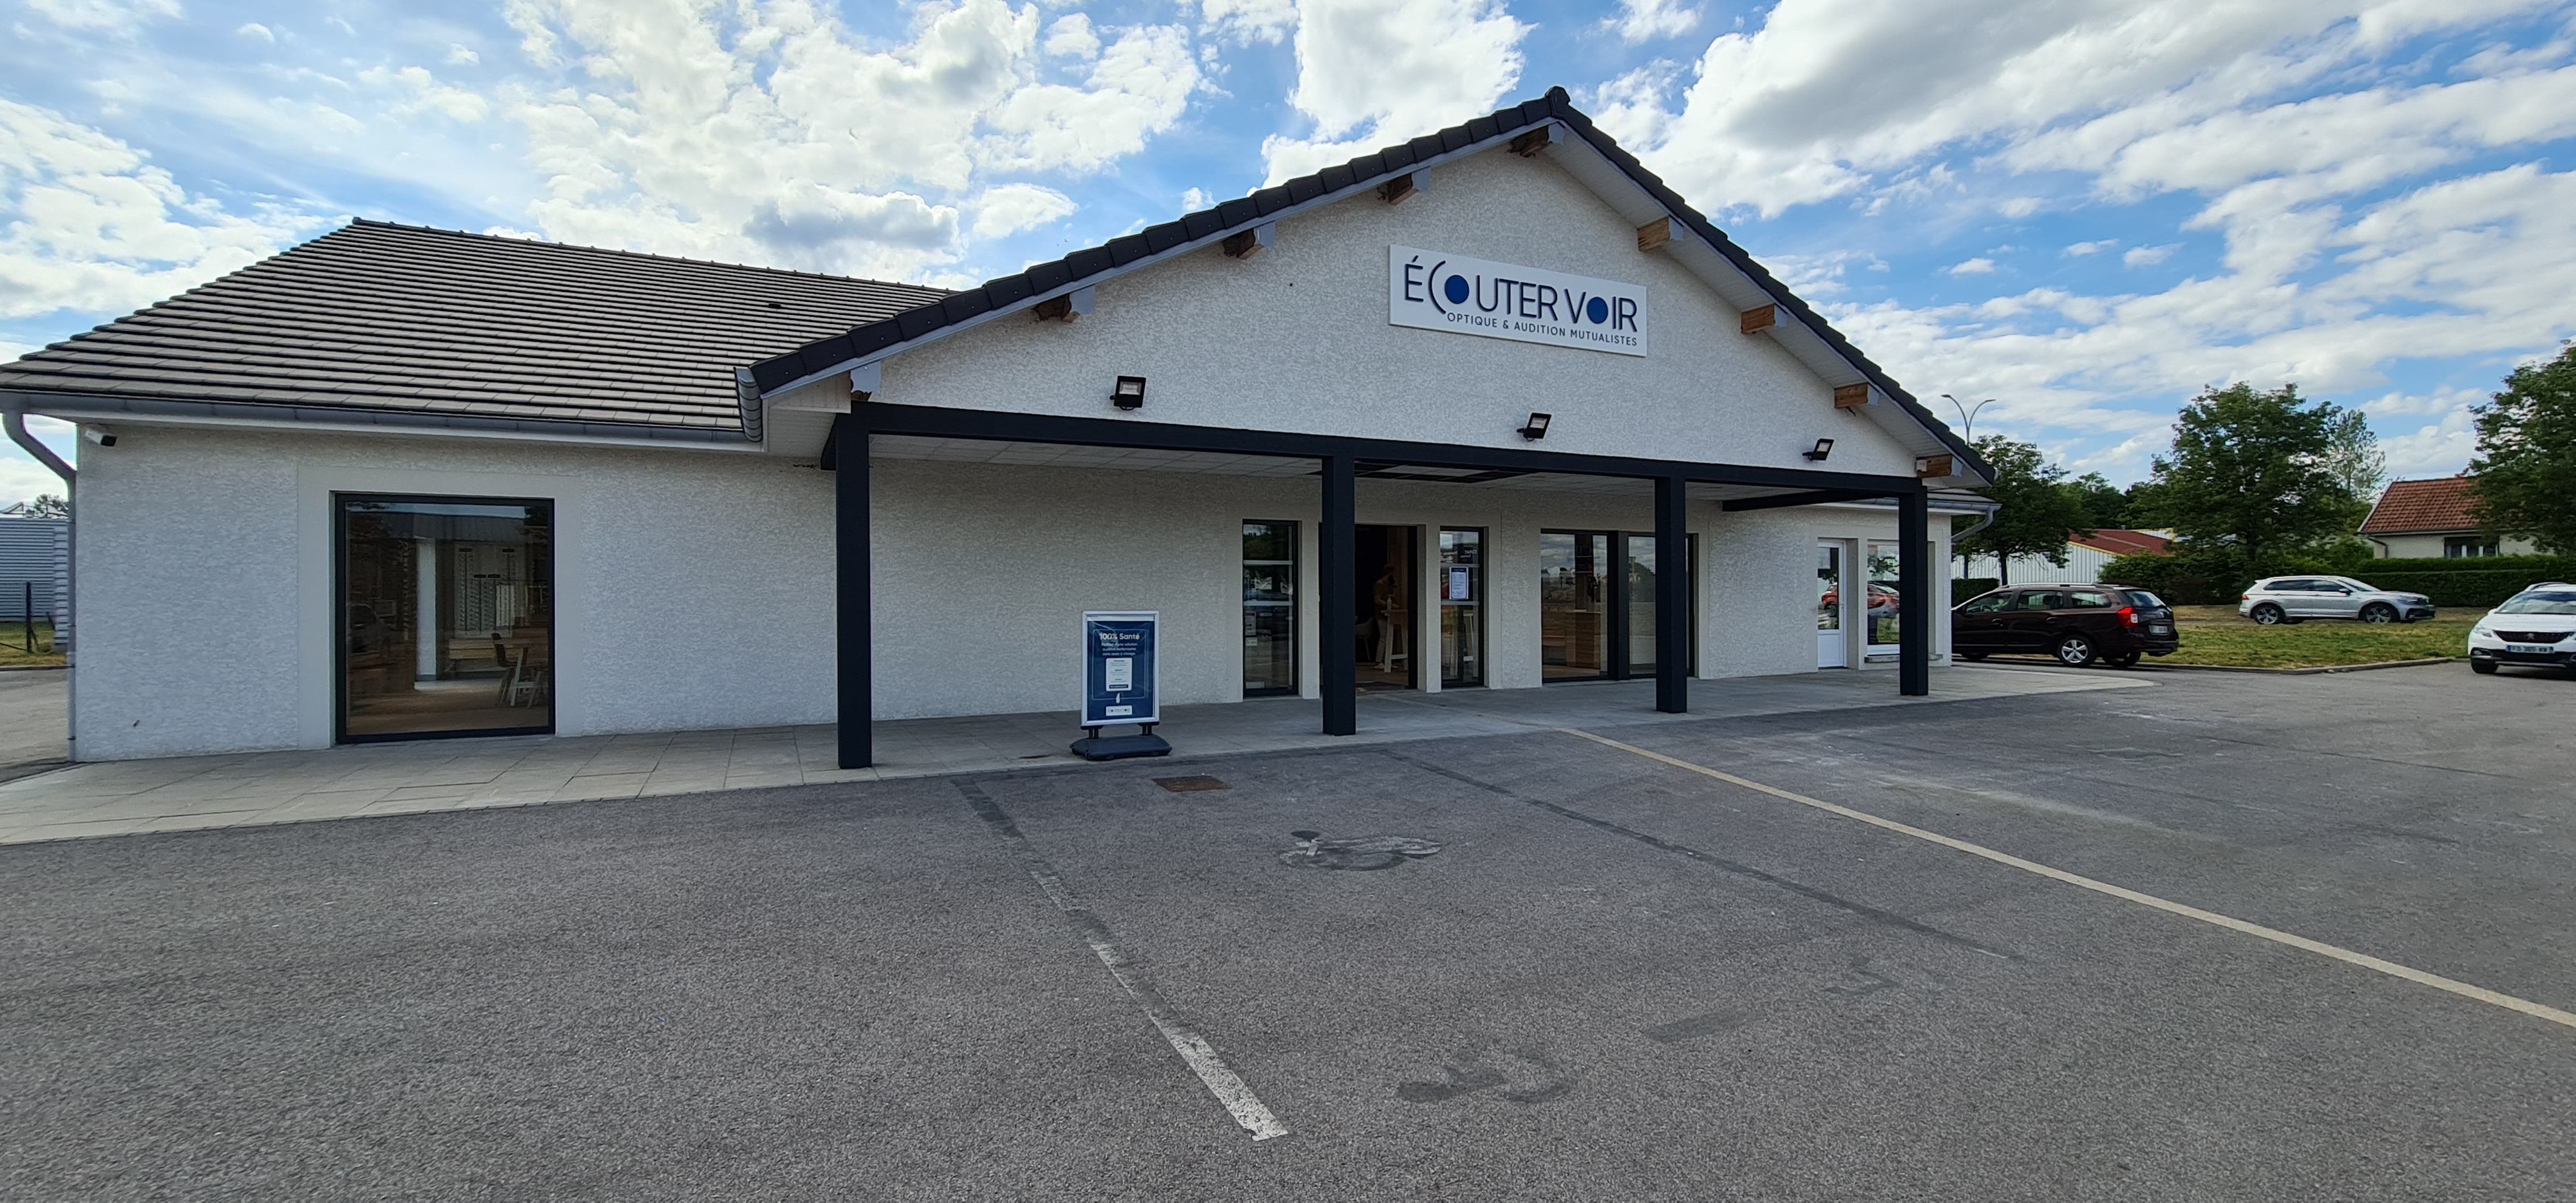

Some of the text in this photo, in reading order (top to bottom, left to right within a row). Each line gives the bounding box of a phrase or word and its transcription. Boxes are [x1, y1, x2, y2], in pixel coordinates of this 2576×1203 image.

[1405, 255, 1638, 332] ÉCOUTER VOIR
[1447, 312, 1637, 346] OPTIQUE & AUDITION MUTUALISTES
